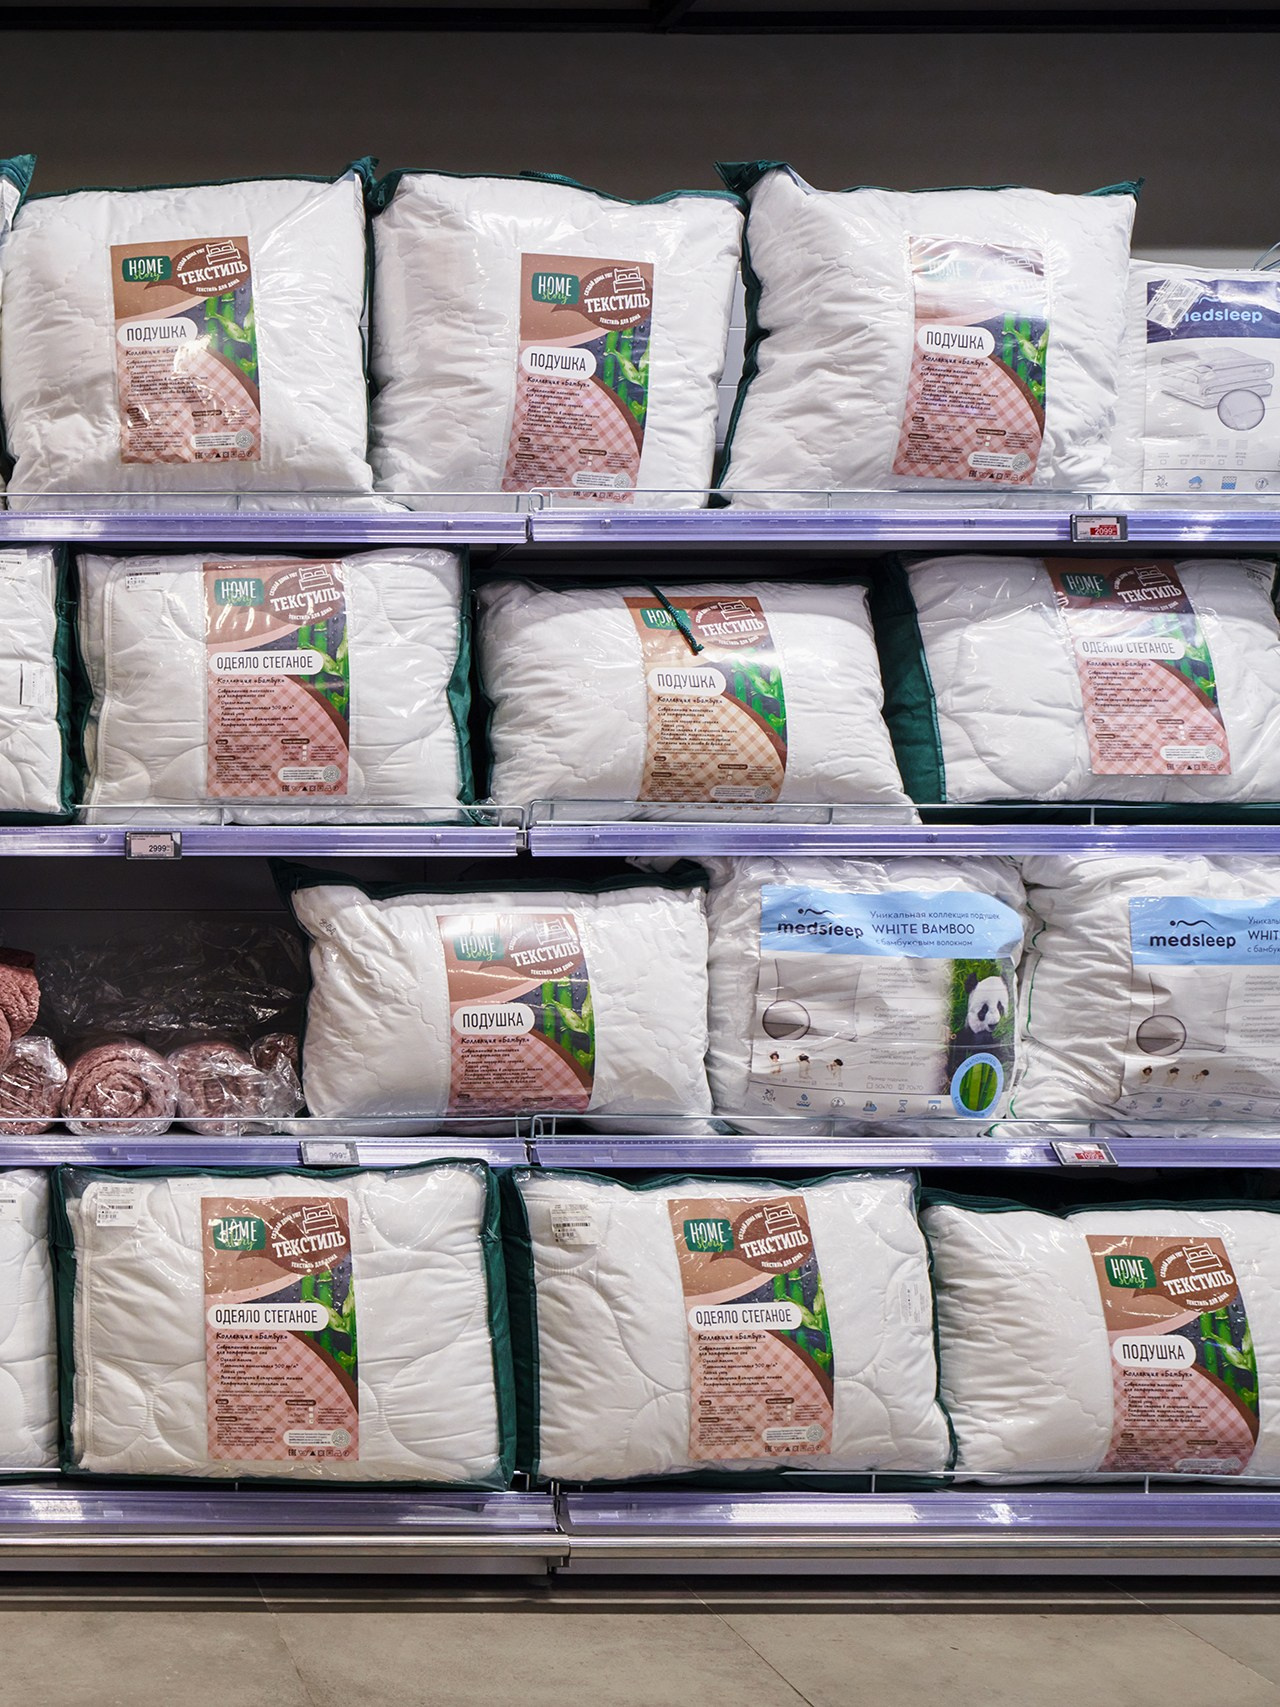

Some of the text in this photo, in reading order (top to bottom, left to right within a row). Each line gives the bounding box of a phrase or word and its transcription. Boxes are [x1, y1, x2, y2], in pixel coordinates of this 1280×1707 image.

[129, 258, 163, 275] HOME
[177, 261, 248, 285] ТЕКСТИЛЬ
[539, 275, 572, 297] HOME
[584, 294, 650, 313] ТЕКСТИЛЬ
[127, 325, 187, 342] ПОДУШКА
[926, 331, 984, 350] ПОДУШКА
[531, 353, 586, 371] ПОДУШКА
[1095, 528, 1113, 536] 2099
[221, 581, 256, 598] HOME
[1117, 585, 1182, 603] ТЕКСТИЛЬ
[270, 588, 340, 612] ТЕКСТИЛЬ
[698, 619, 765, 636] ТЕКСТИЛЬ
[1127, 642, 1175, 653] СТЕГАНОЕ
[217, 656, 312, 670] ОДЕЯЛО СТЕГАНОЕ
[658, 674, 716, 689] ПОДУШКА
[149, 844, 167, 853] 2999
[870, 910, 927, 920] Уникальная
[928, 911, 969, 920] коллекция
[777, 921, 864, 939] medsleep
[871, 923, 975, 935] WHITE BAMBOO
[460, 935, 496, 953] HOME
[1150, 932, 1237, 950] medsleep
[466, 949, 493, 961] story
[510, 942, 580, 966] ТЕКСТИЛЬ
[463, 1013, 524, 1029] ПОДУШКА
[689, 1222, 726, 1243] HOME
[272, 1231, 346, 1258] ТЕКСТИЛЬ
[696, 1239, 723, 1252] story
[740, 1230, 809, 1258] ТЕКСТИЛЬ
[1110, 1259, 1148, 1280] HOME
[1163, 1271, 1233, 1296] ТЕКСТИЛЬ
[216, 1310, 317, 1324] ОДЕЯЛО СТЕГАНОЕ
[696, 1308, 793, 1326] ОДЕЯЛО СТЕГАНОЕ
[1123, 1344, 1185, 1362] ПОДУШКА
